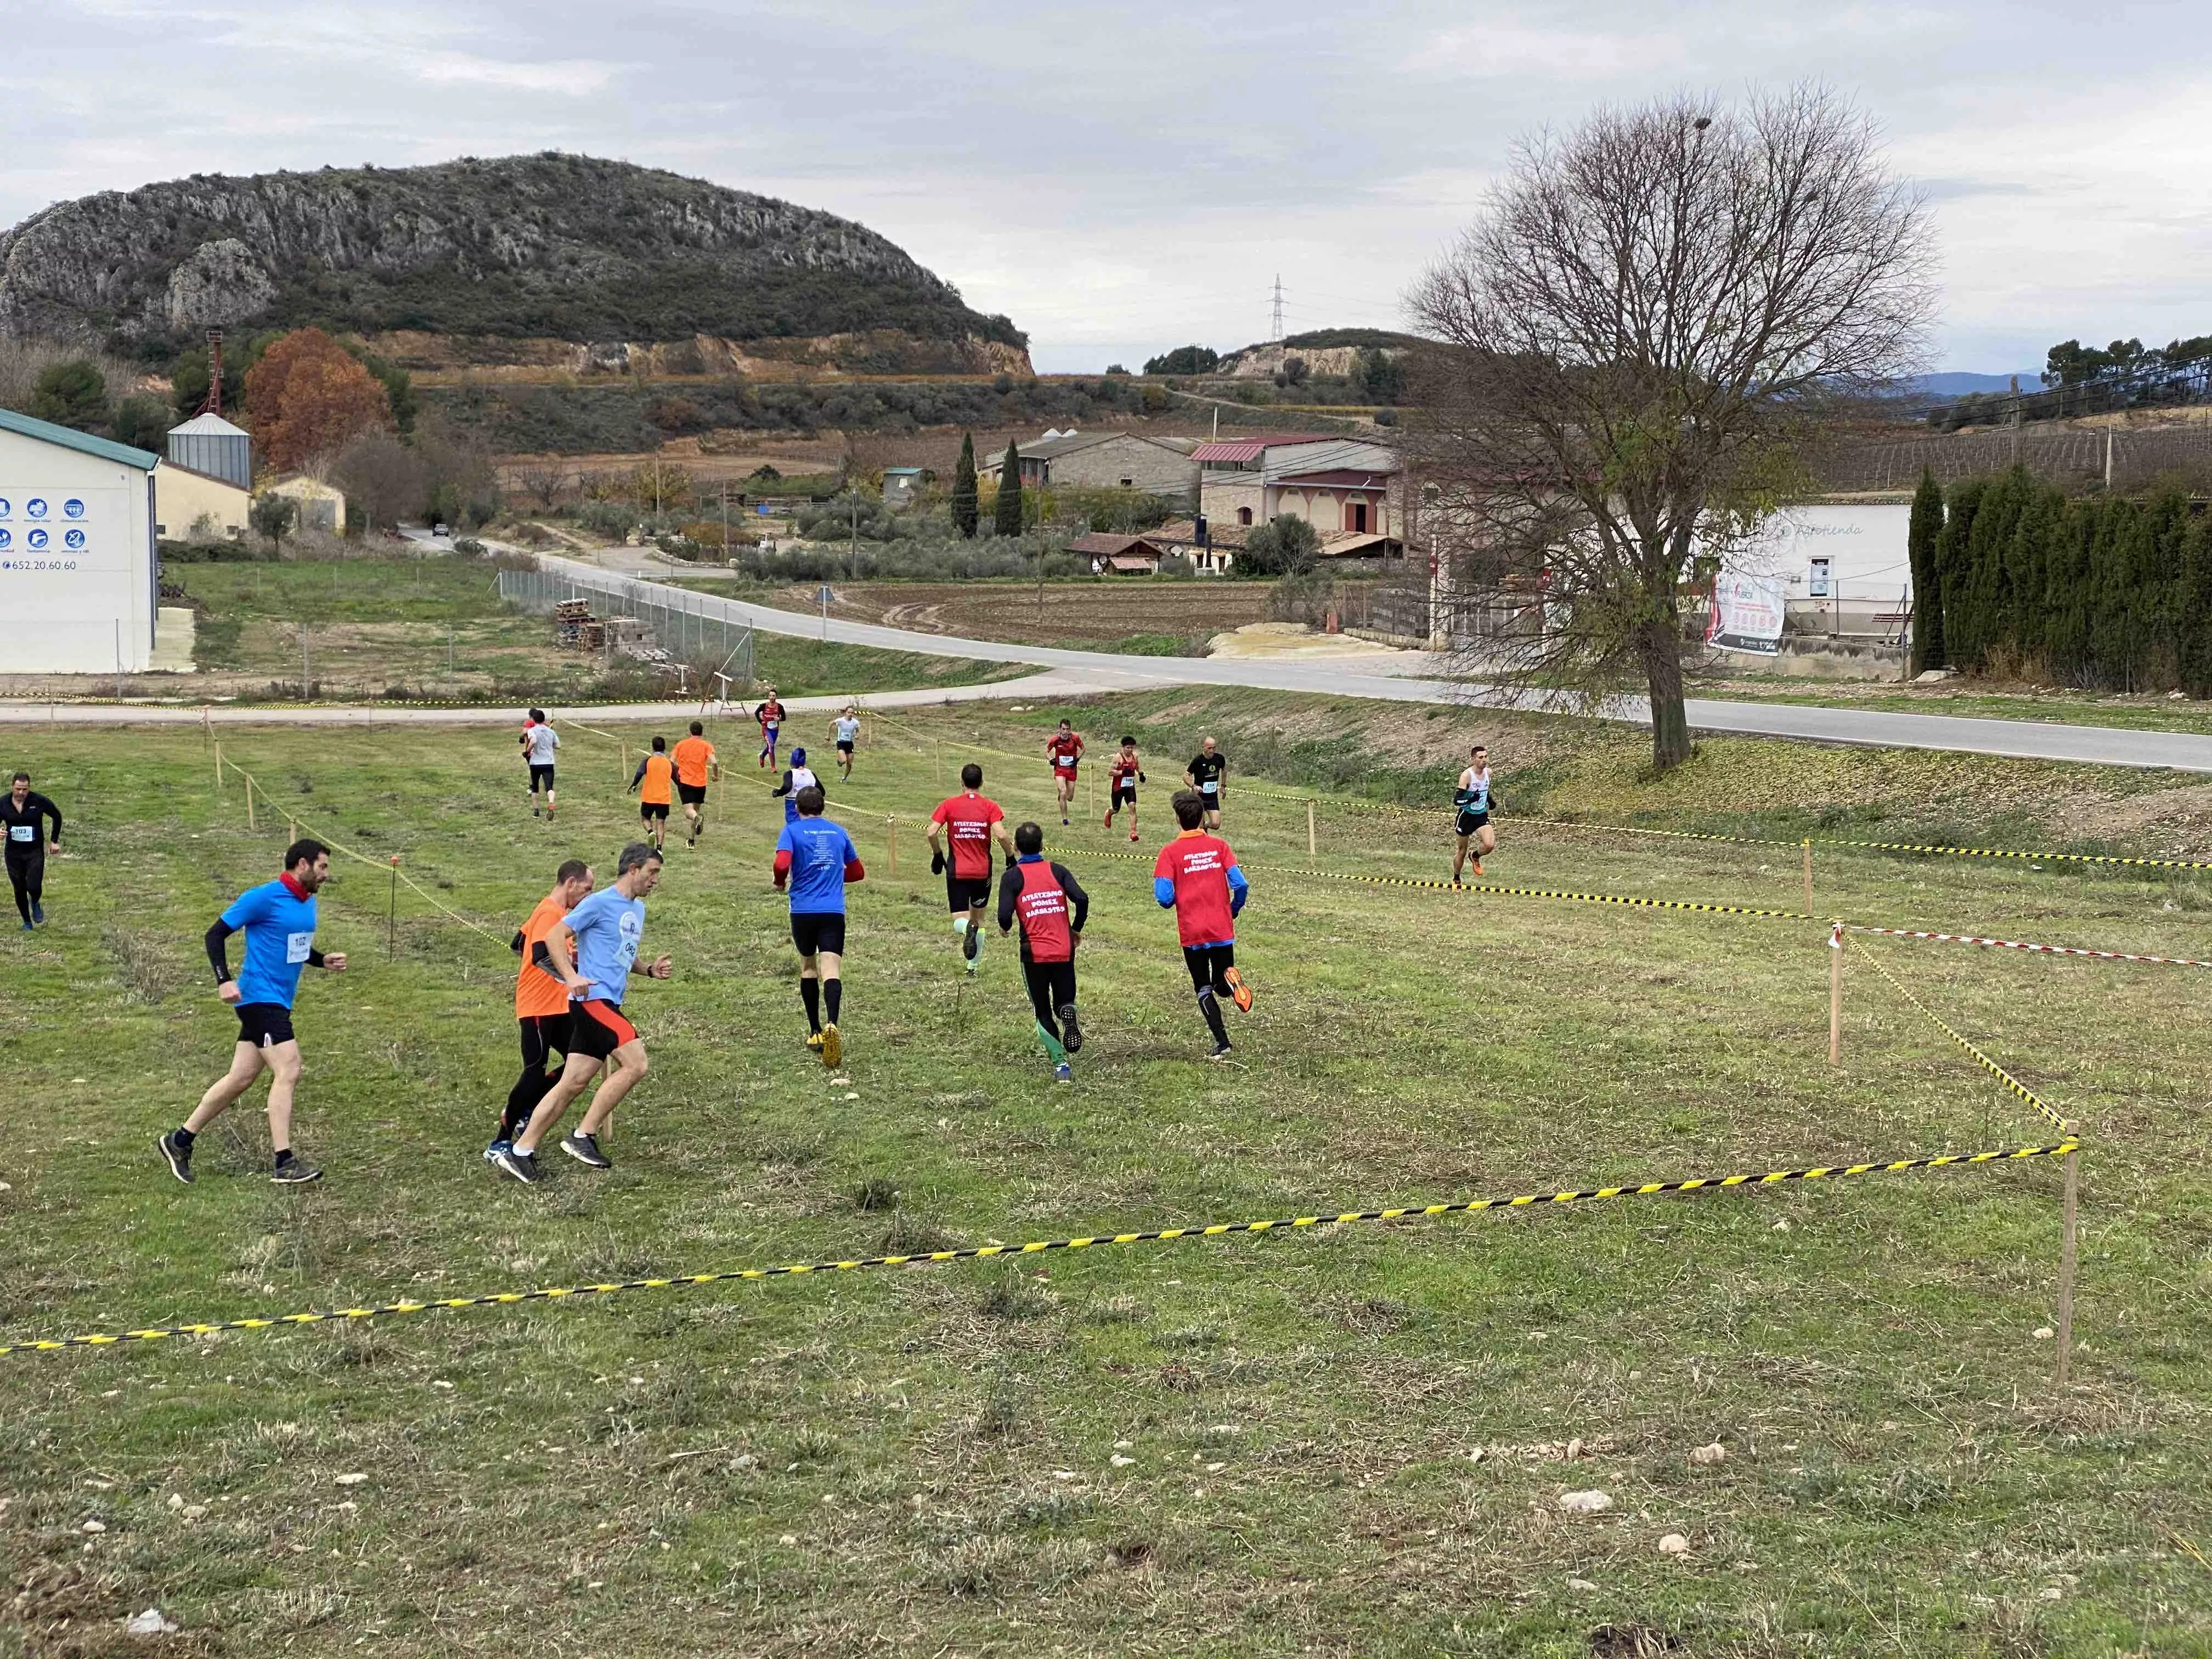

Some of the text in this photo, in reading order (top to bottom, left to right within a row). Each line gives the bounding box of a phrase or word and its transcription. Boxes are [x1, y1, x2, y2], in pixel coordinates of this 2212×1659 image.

[1795, 523, 1864, 539] Agrotienda
[12, 561, 76, 570] 652.20.60.60
[1022, 890, 1063, 902] ATLETISMO
[1025, 906, 1065, 918] BARBASTRO
